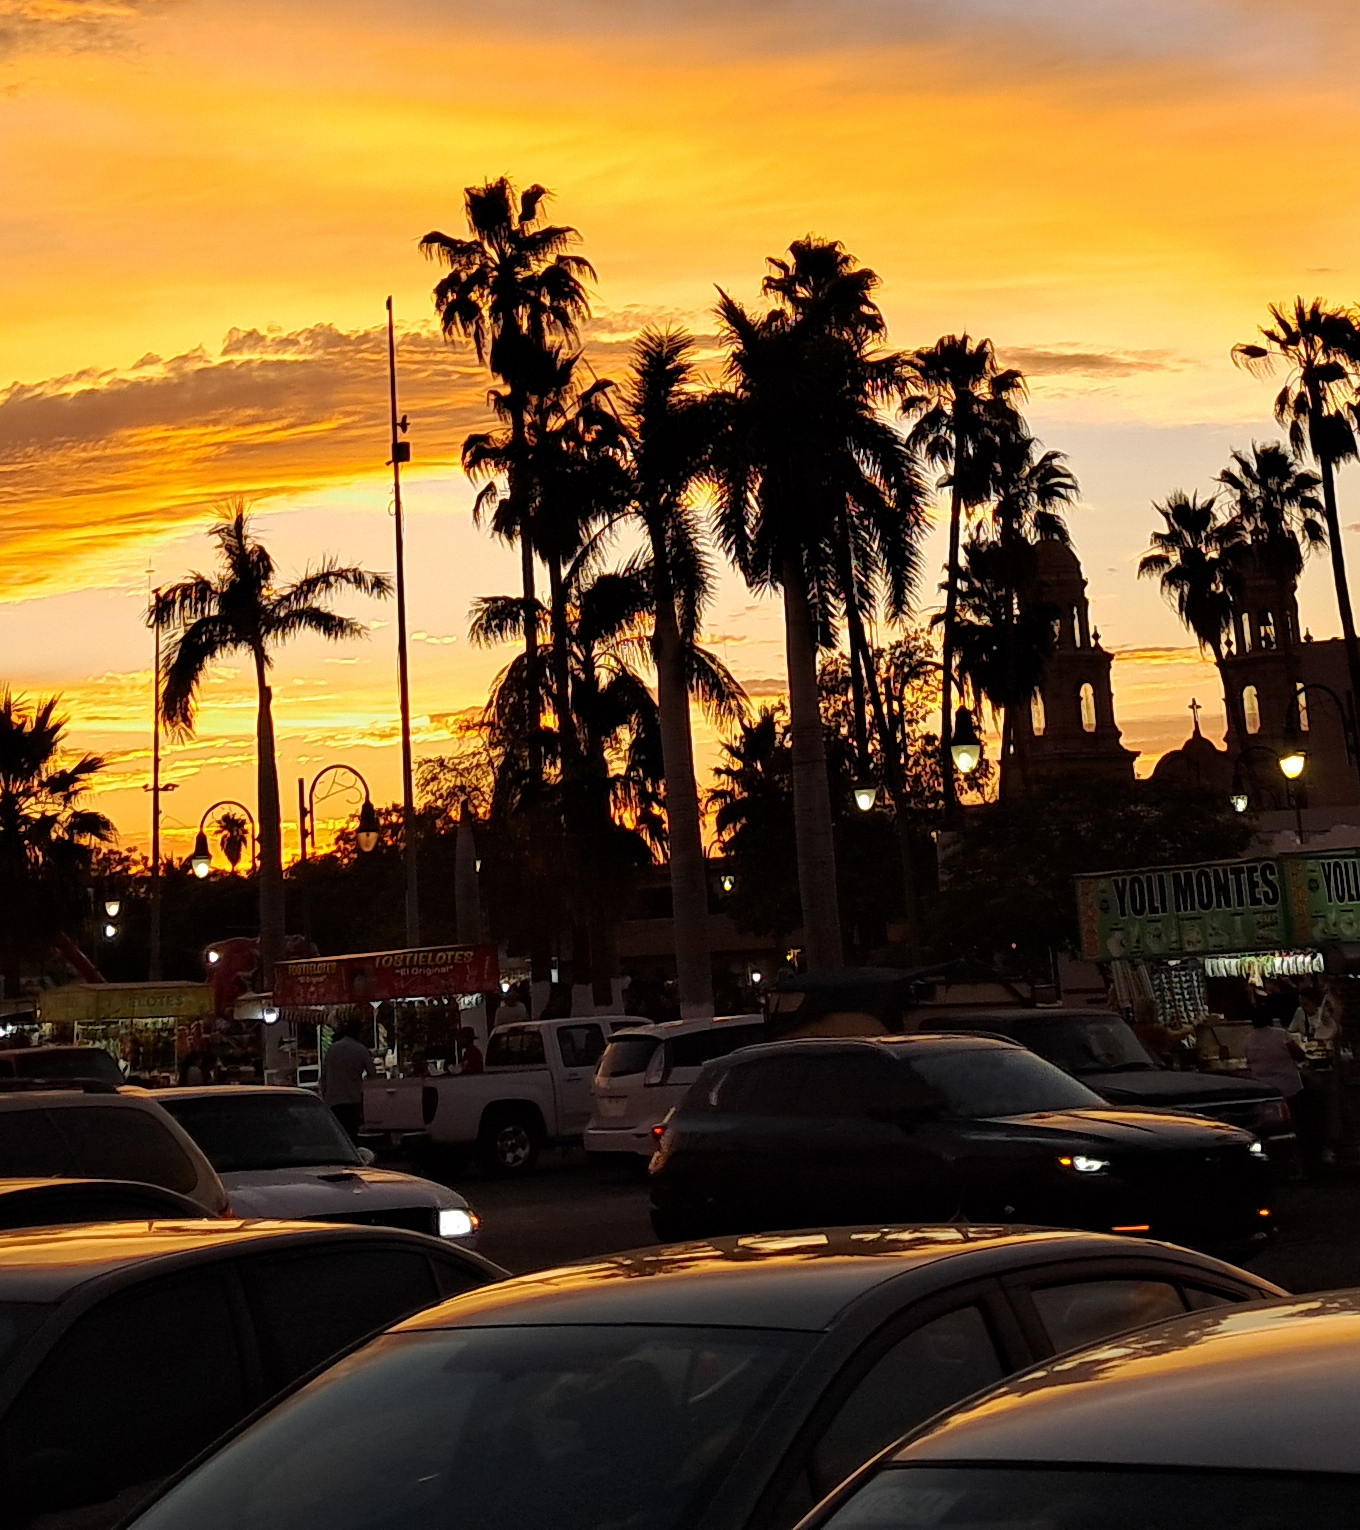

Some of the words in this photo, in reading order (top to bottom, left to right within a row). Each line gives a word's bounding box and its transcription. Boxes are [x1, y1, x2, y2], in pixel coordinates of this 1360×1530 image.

[1113, 872, 1168, 918] YOLI
[1172, 862, 1281, 913] MONTES
[1321, 861, 1360, 903] YOLI
